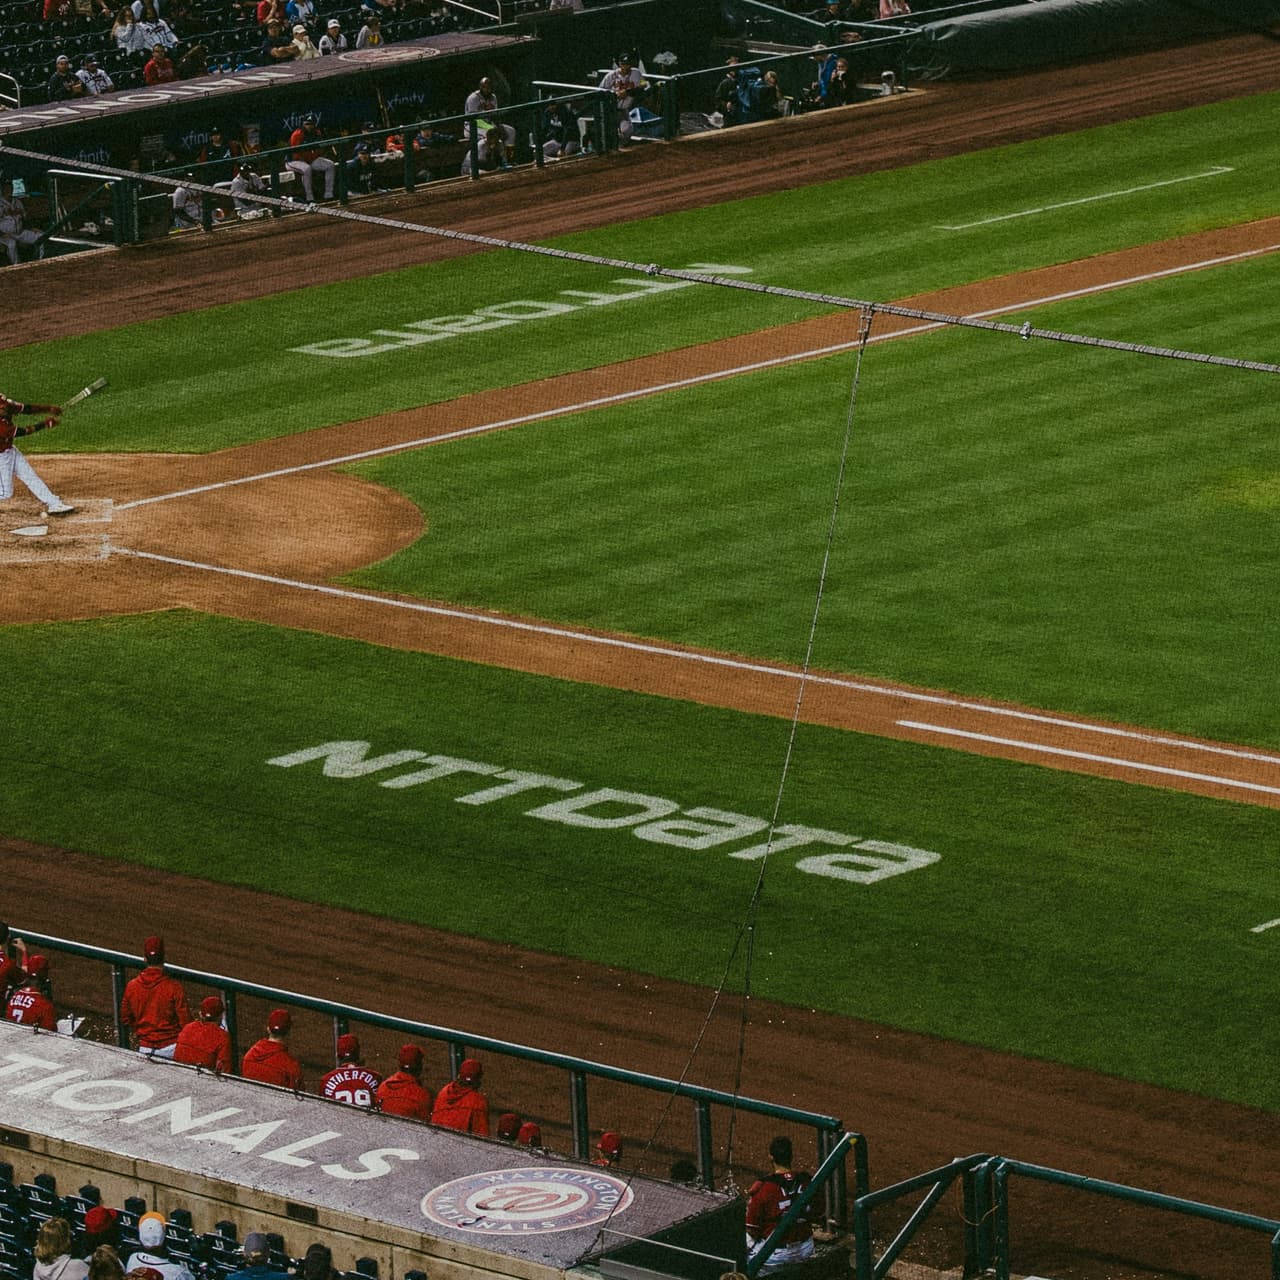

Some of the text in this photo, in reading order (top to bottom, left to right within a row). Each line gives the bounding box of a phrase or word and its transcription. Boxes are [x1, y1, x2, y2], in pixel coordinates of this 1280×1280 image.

[324, 1069, 377, 1097] RUTHERFOR
[481, 1171, 619, 1212] WASHINGTON
[434, 1195, 556, 1231] NATIONALS
